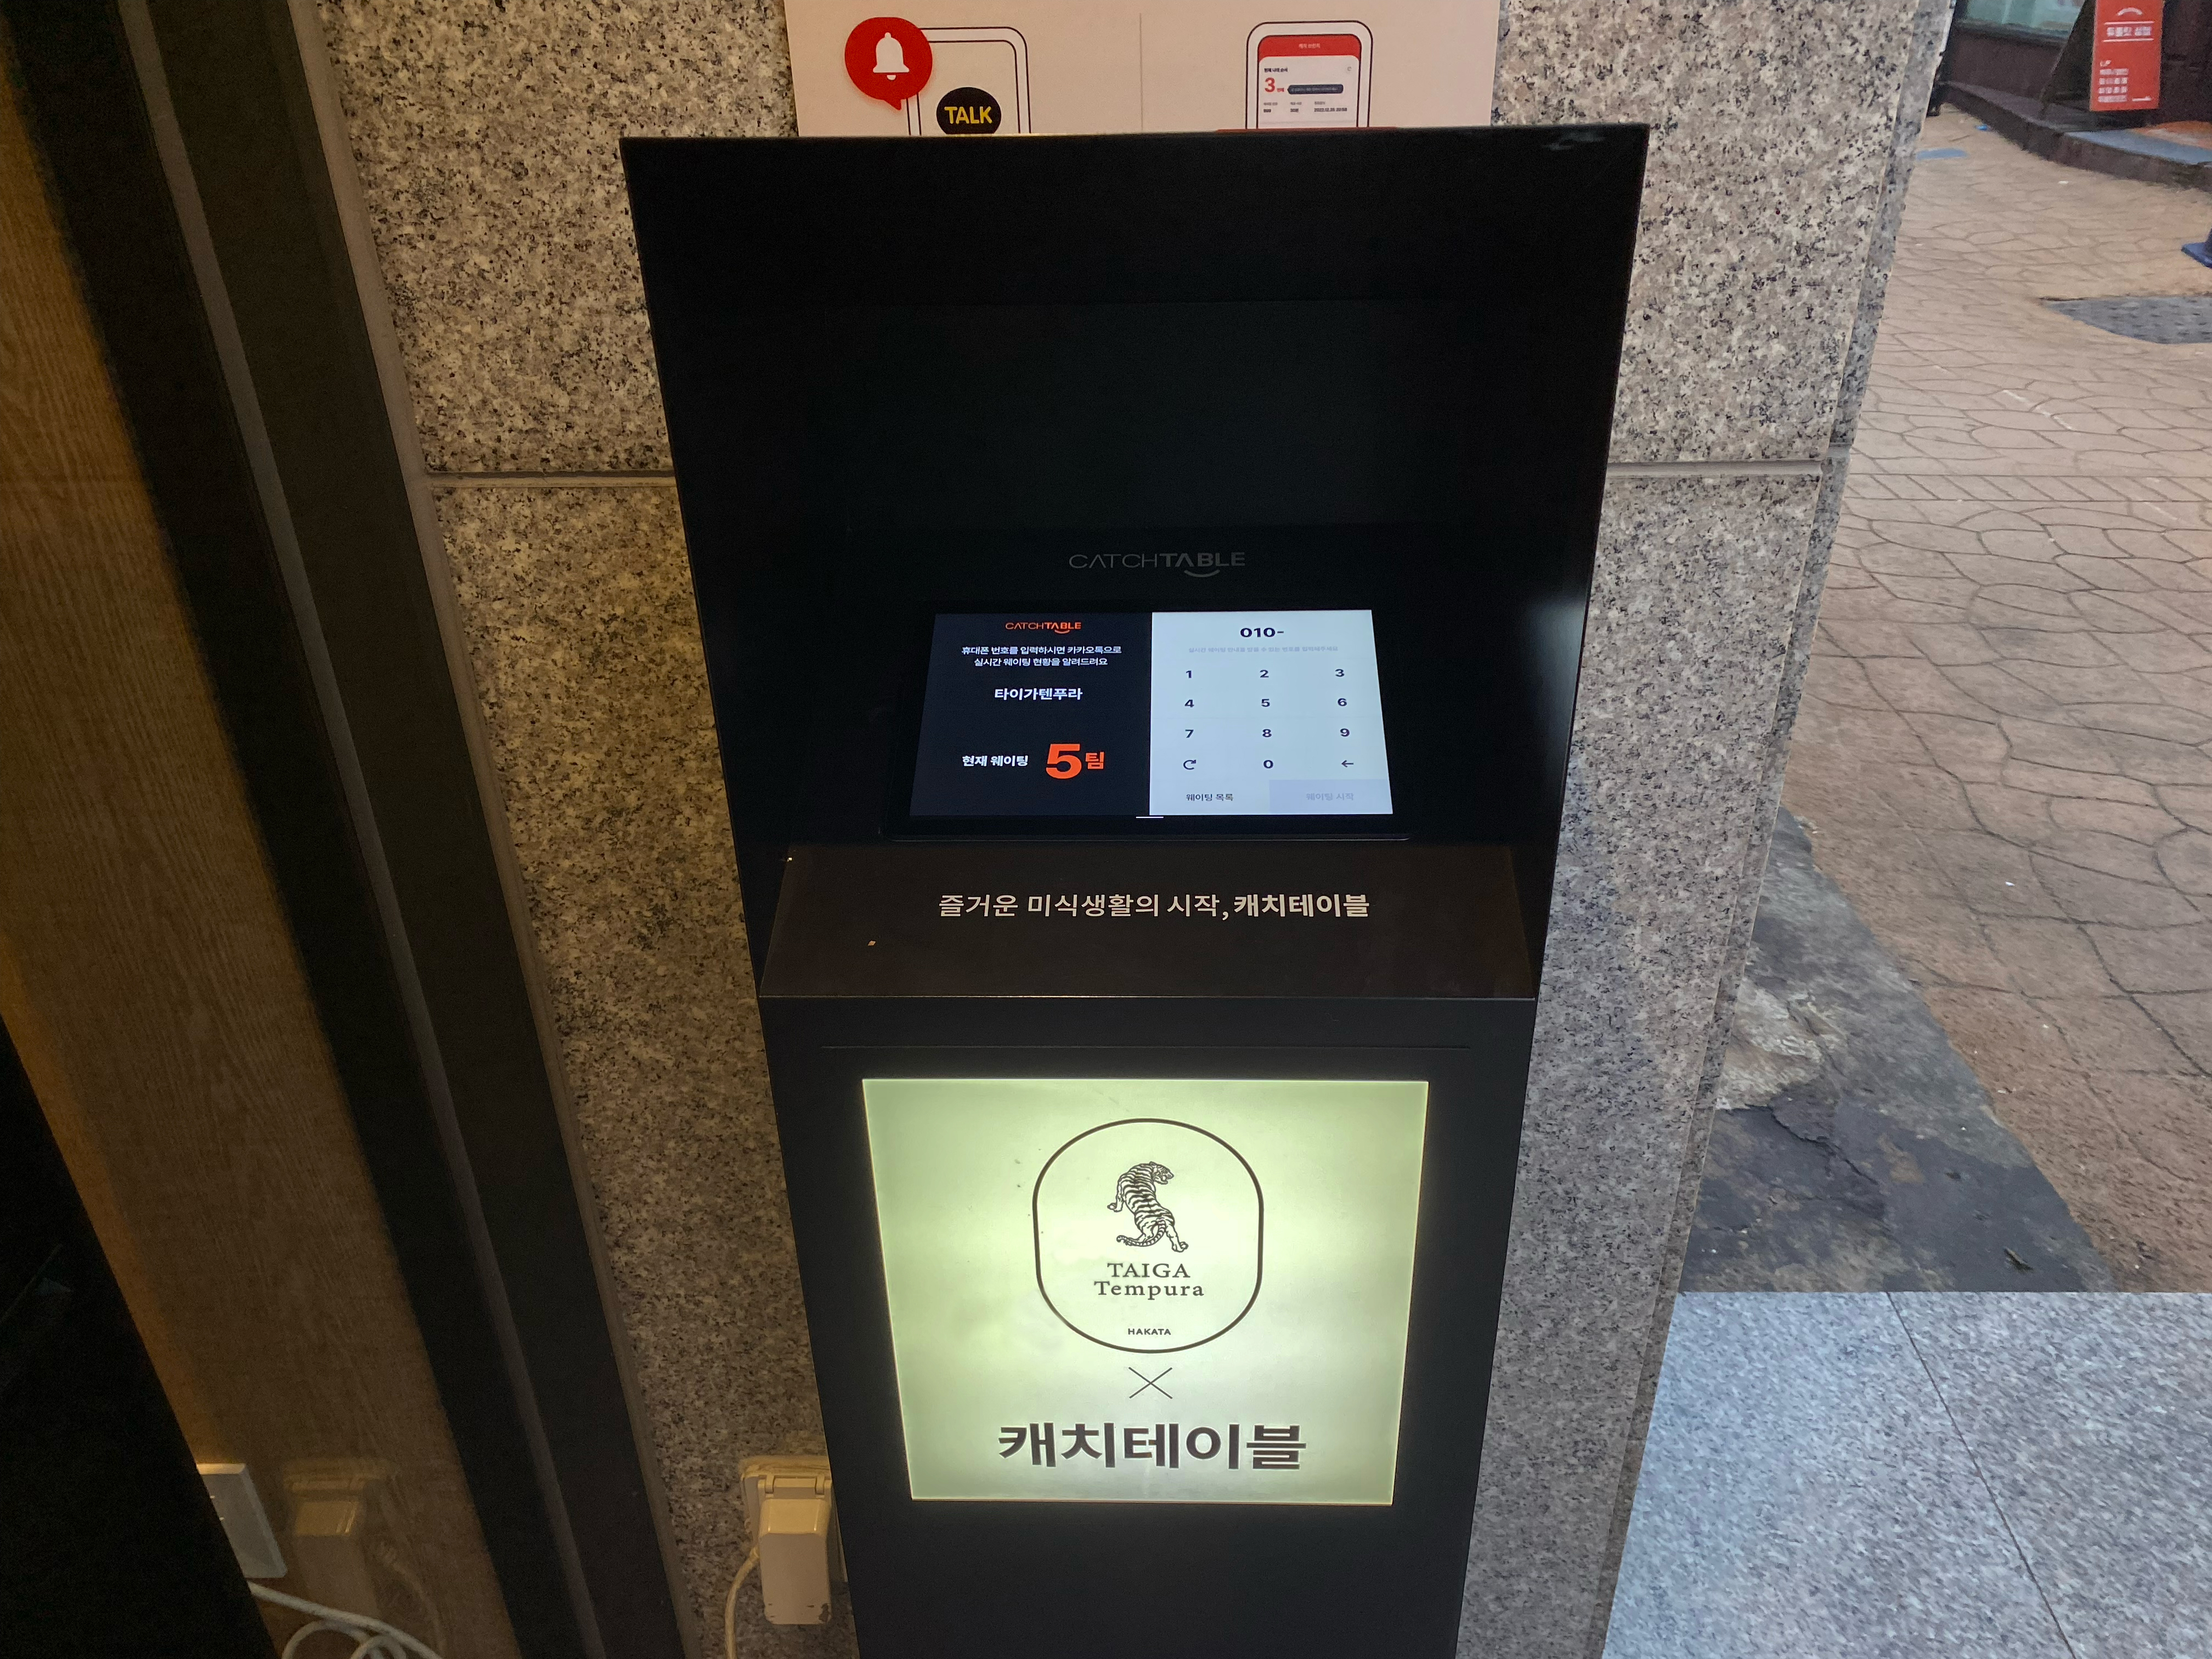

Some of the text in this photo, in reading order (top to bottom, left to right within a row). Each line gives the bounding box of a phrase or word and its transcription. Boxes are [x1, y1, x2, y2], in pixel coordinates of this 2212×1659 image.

[1265, 77, 1276, 93] 3
[944, 106, 992, 125] TALK
[1069, 552, 1245, 578] CATCHTABLE
[1005, 622, 1081, 634] CATCHTABLE
[961, 646, 1122, 655] 휴대폰 번호를 입력하시면 카카오톡으로
[974, 657, 1108, 667] 실시간 웨이팅 현황을 알려드려요
[1186, 670, 1192, 679] 1
[1260, 669, 1269, 678] 2
[1335, 669, 1345, 678] 3
[994, 687, 1083, 701] 타이가텐푸라
[1184, 699, 1194, 708] 4
[1261, 698, 1270, 707] 5
[1338, 698, 1347, 707] 6
[1185, 729, 1194, 738] 7
[1262, 729, 1272, 738] 8
[1340, 728, 1350, 737] 9
[962, 743, 1104, 780] 현재 웨이팅 5 팀
[1263, 759, 1274, 769] 0
[1186, 793, 1234, 802] 웨이팅 목록
[1306, 792, 1355, 801] 웨이팅 시작
[939, 894, 1370, 921] 즐거운 미식생활의 시작, 캐치테이블
[1107, 1262, 1191, 1278] TAIGA
[1093, 1280, 1205, 1301] Tempura
[998, 1421, 1307, 1470] 캐치테이블
